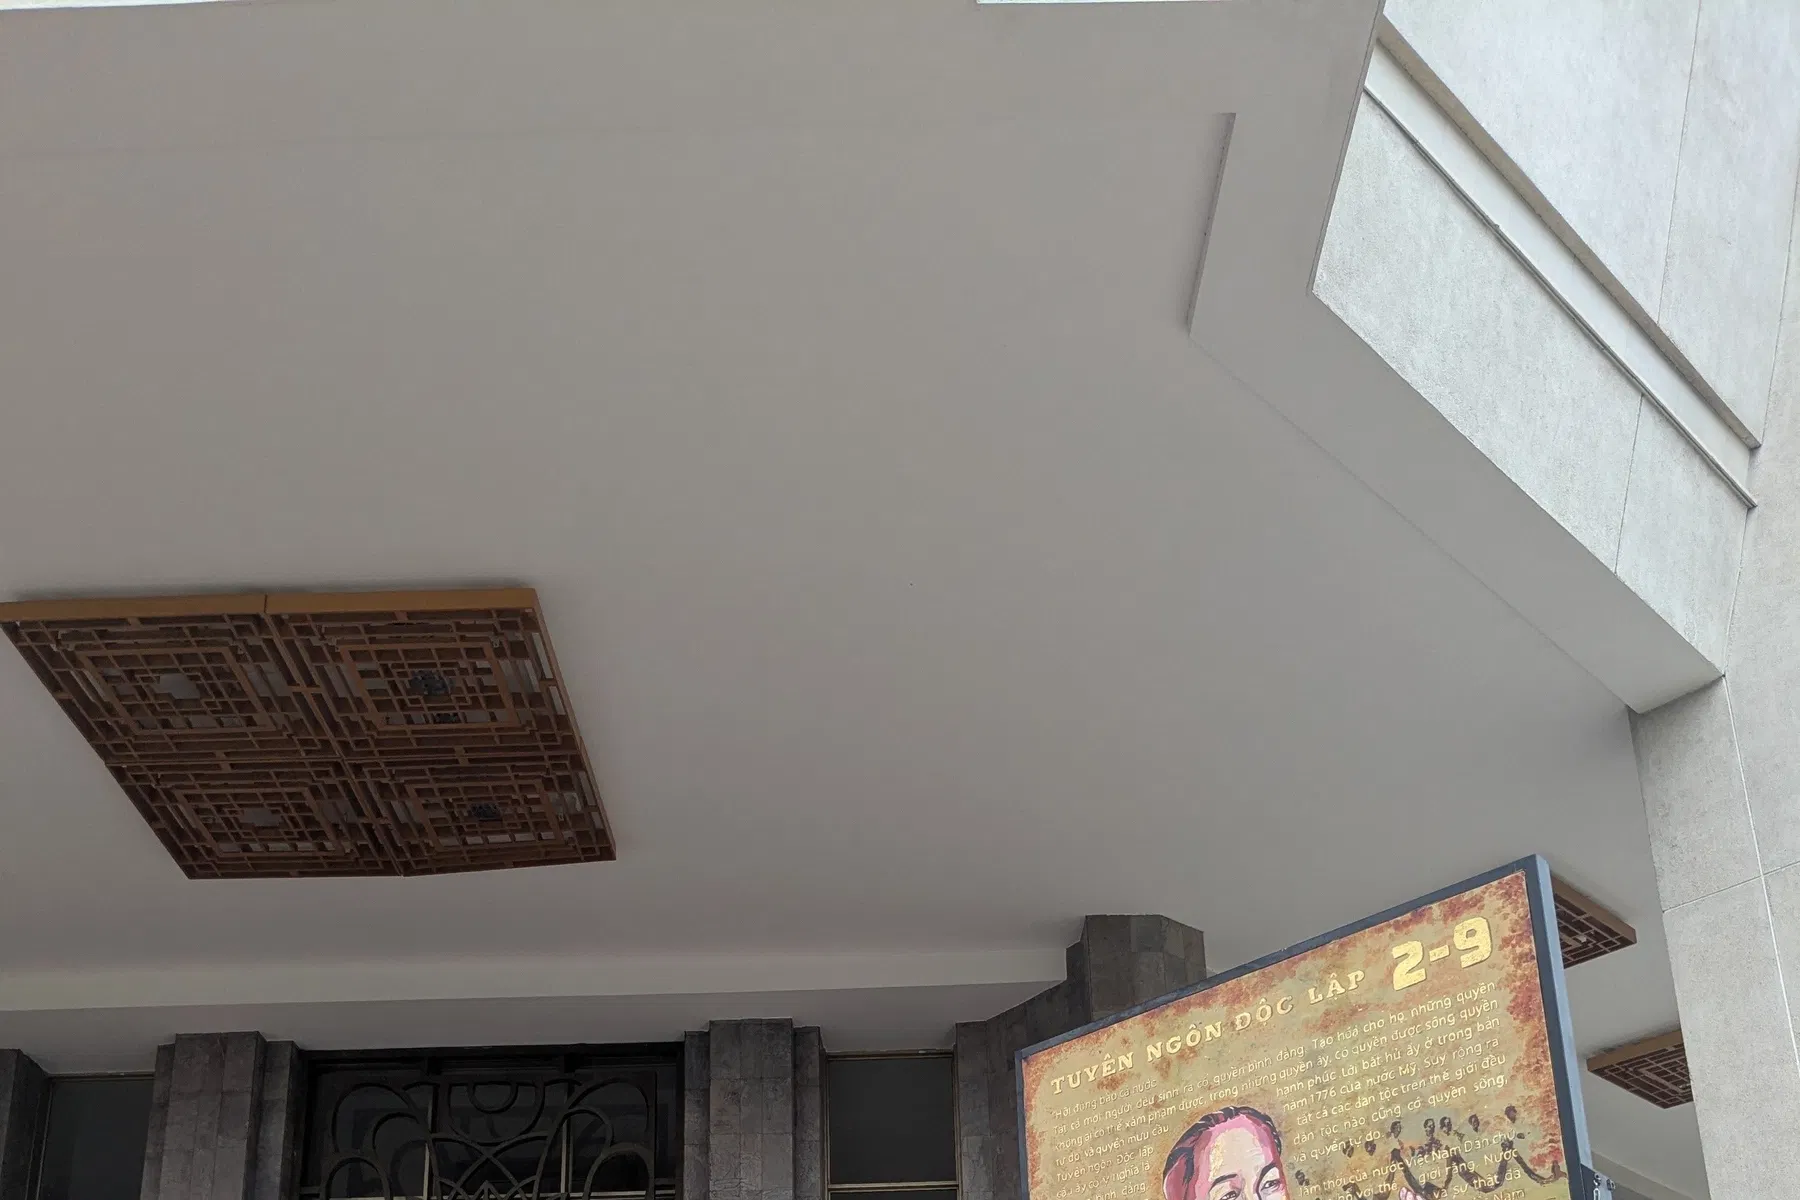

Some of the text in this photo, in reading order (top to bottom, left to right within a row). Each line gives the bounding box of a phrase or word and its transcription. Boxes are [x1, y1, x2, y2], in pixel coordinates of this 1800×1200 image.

[1391, 916, 1492, 991] 2-9
[1050, 969, 1365, 1095] TUYÊN NGÔN ĐỘC LẬP
[1183, 1084, 1194, 1093] ra
[1312, 1036, 1334, 1049] Tạo
[1363, 1019, 1384, 1032] cho
[1410, 996, 1452, 1017] những
[1457, 982, 1495, 1004] quyền
[1210, 1085, 1239, 1101] trong
[1280, 1060, 1313, 1079] quyền
[1351, 1036, 1387, 1055] quyền
[1460, 999, 1498, 1020] quyền
[1310, 1086, 1337, 1103] 1776
[1340, 1080, 1361, 1095] của
[1423, 1054, 1447, 1068] Suy
[1452, 1043, 1482, 1060] rộng
[1486, 1038, 1499, 1049] ra
[1068, 1153, 1080, 1163] do
[1438, 1027, 1472, 1045] trong
[1476, 1015, 1500, 1032] bản
[1428, 1085, 1466, 1107] quyền
[1431, 1146, 1460, 1160] Nam
